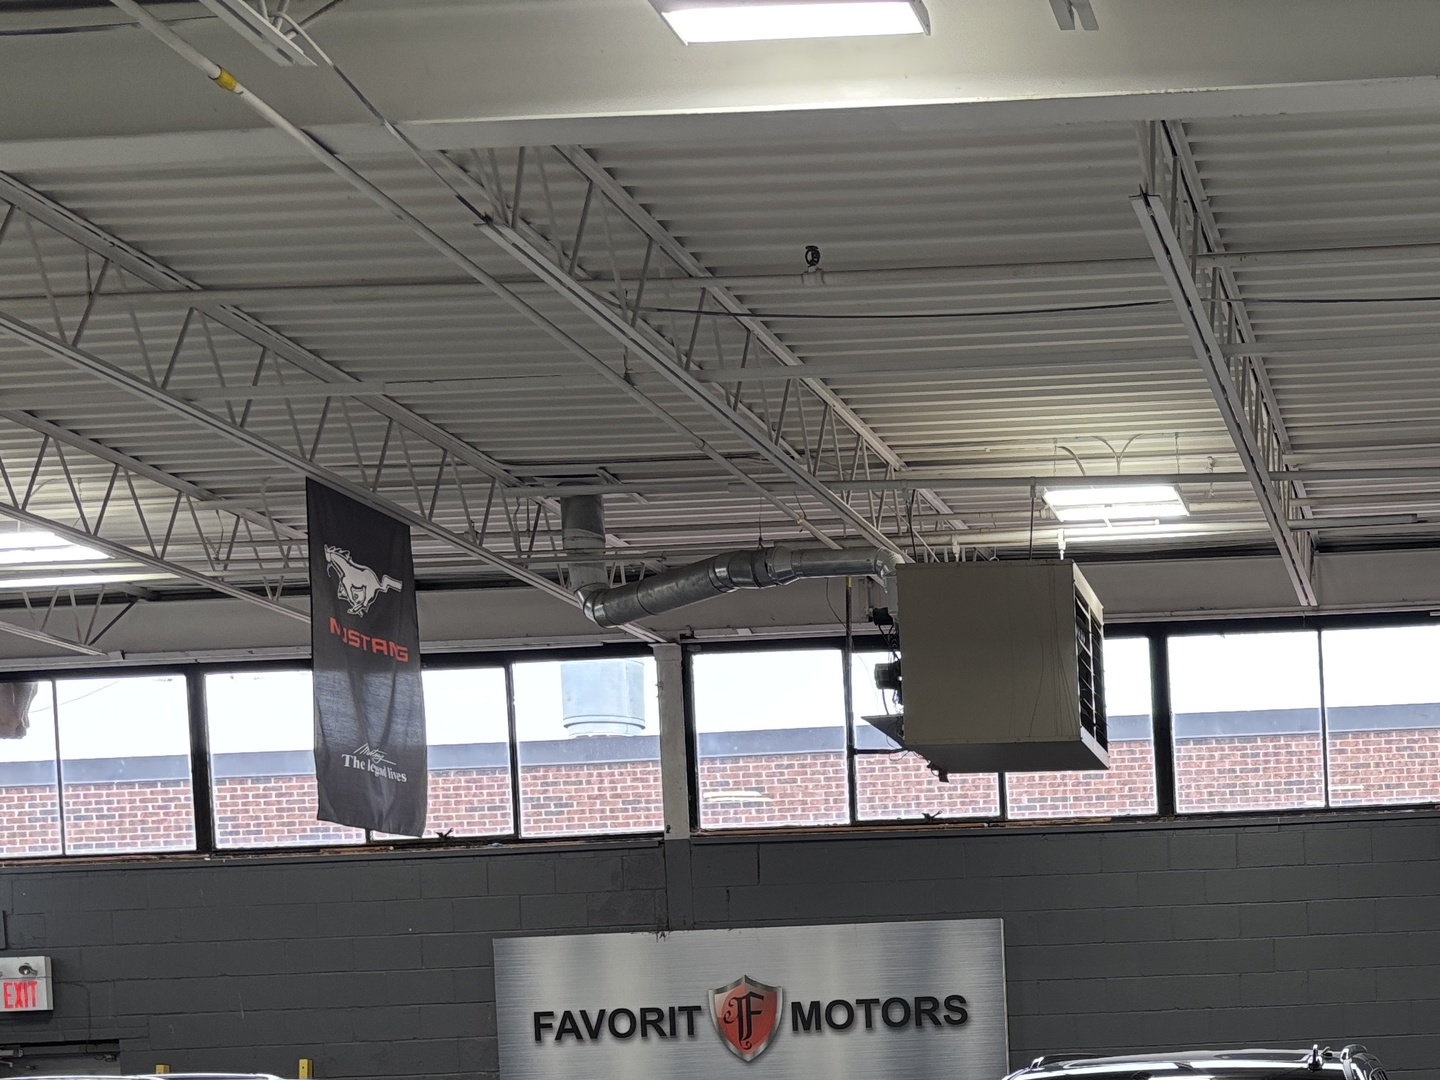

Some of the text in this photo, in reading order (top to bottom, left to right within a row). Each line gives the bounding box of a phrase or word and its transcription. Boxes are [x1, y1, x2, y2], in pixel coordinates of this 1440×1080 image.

[341, 753, 366, 770] The
[387, 767, 408, 782] lives
[3, 981, 38, 1009] EXIT
[533, 1005, 702, 1041] FAVORIT
[791, 994, 968, 1032] MOTORS
